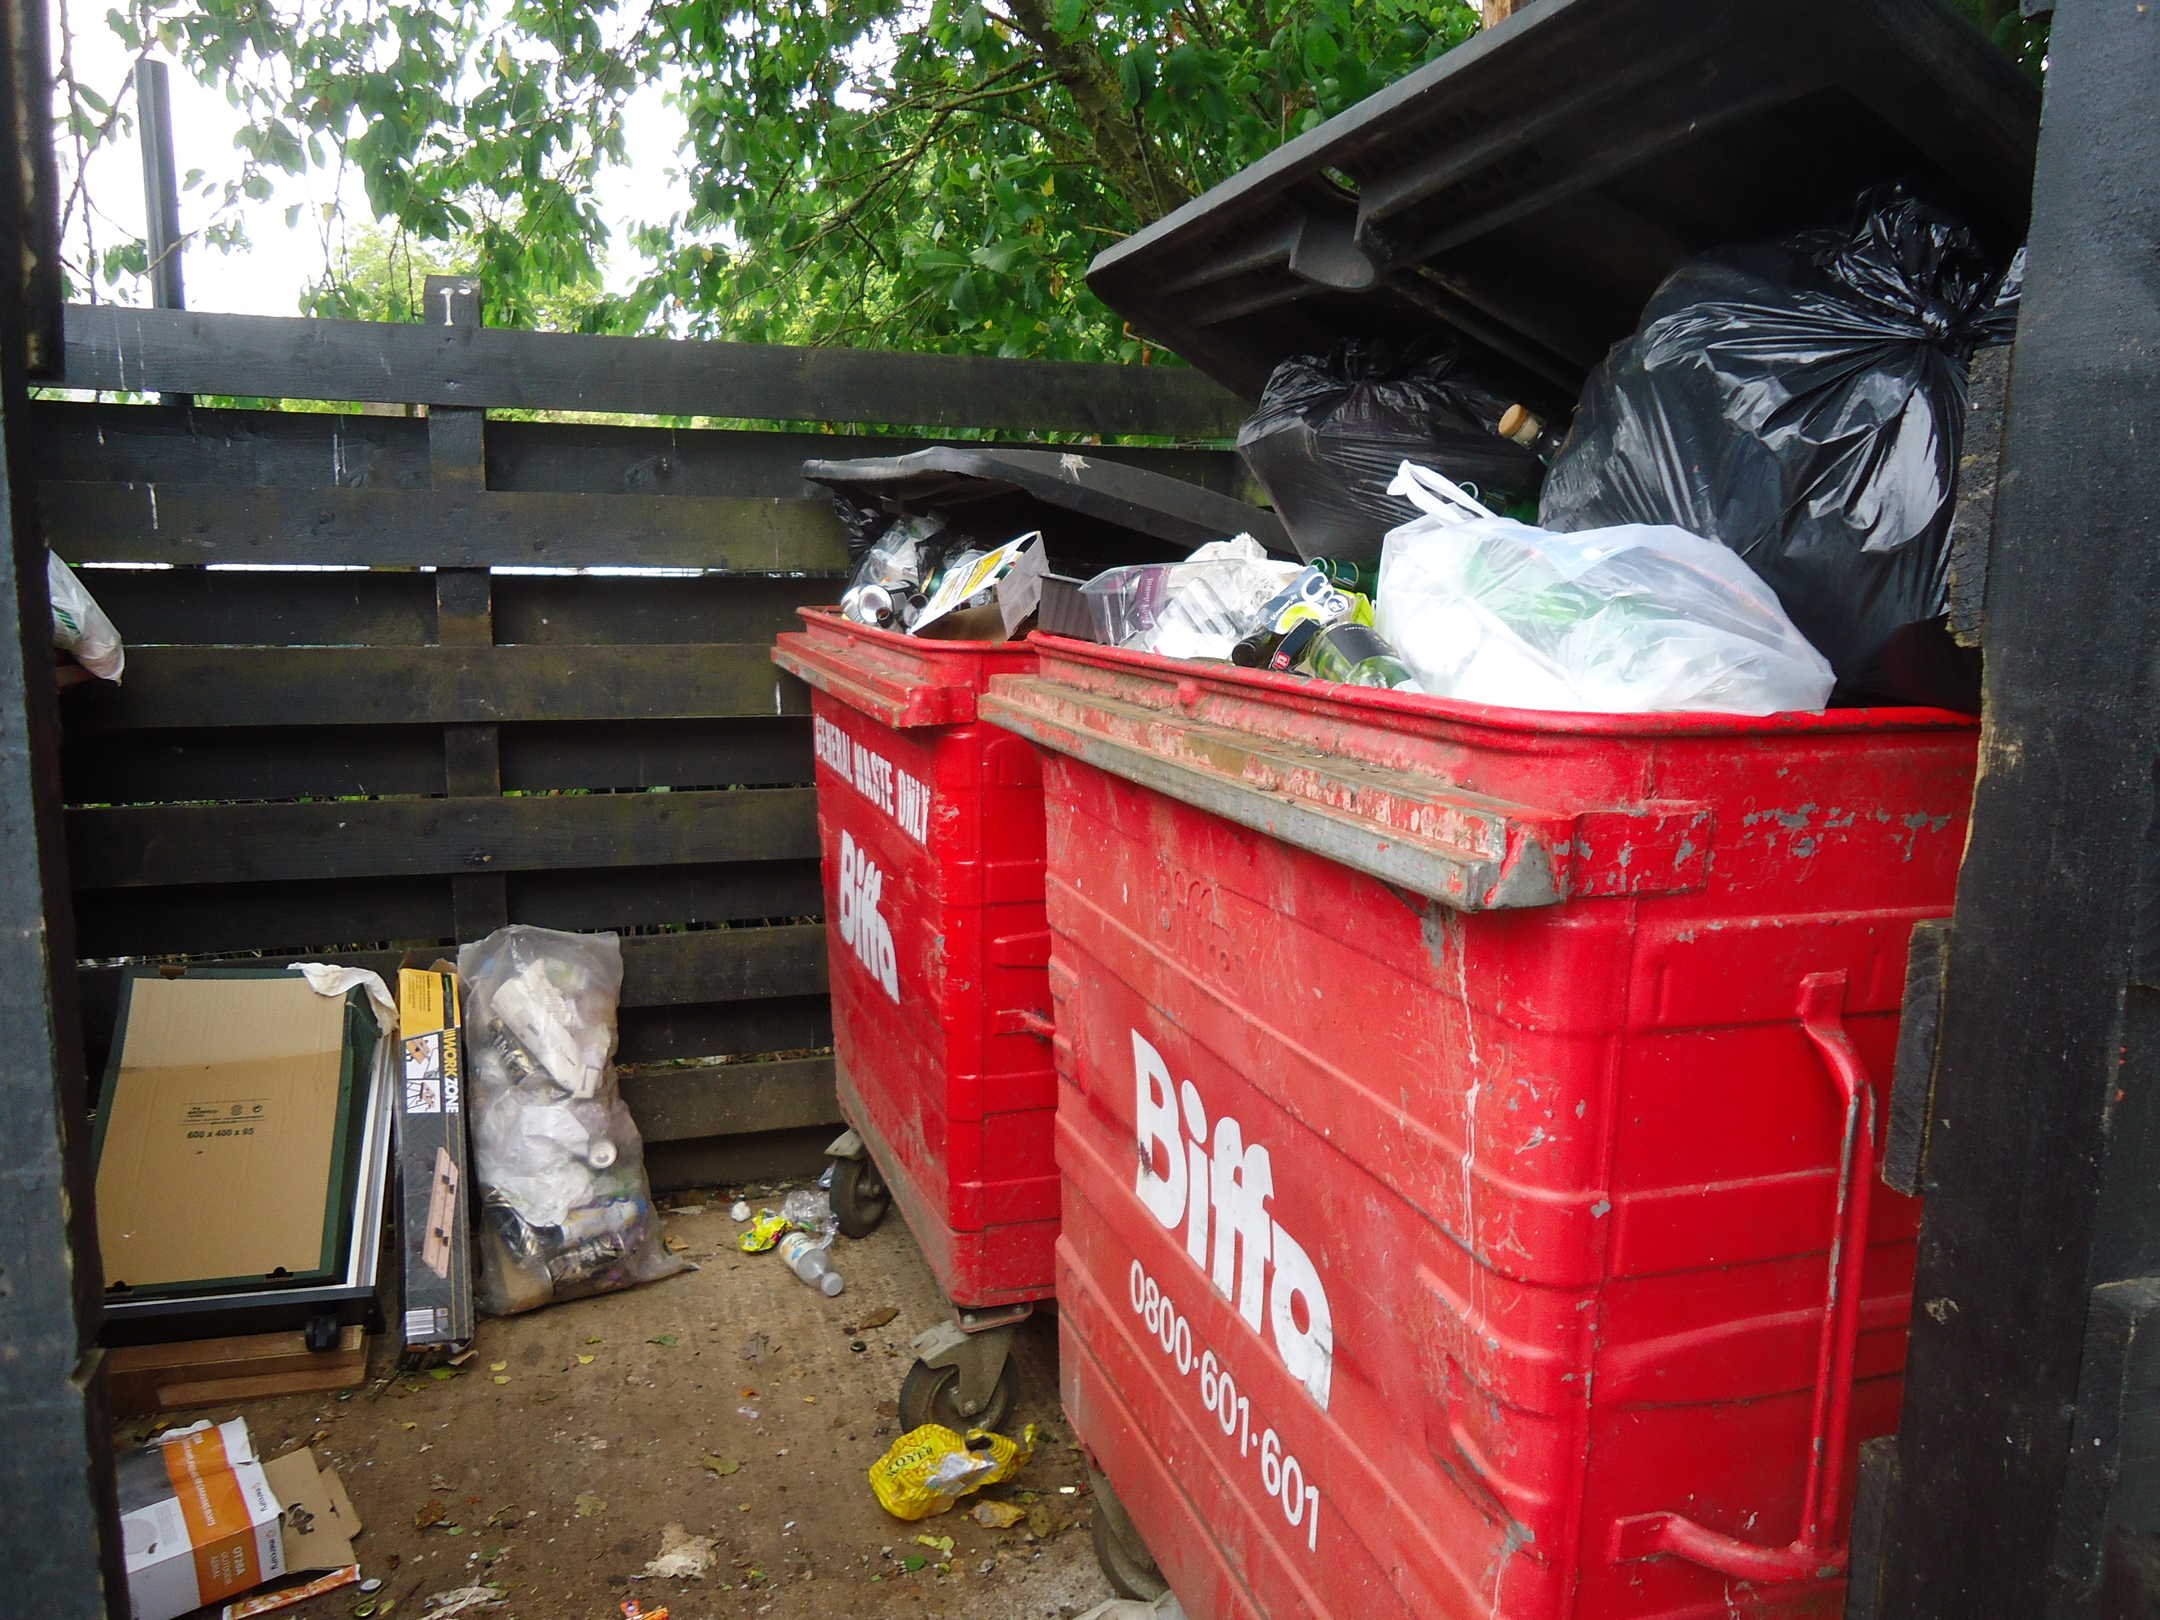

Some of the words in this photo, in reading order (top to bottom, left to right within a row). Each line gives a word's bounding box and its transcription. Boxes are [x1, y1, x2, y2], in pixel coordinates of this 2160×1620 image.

[854, 741, 894, 817] WASTE
[898, 768, 931, 846] ONLY
[839, 828, 900, 1005] Biffa
[1131, 1028, 1334, 1413] Biffa
